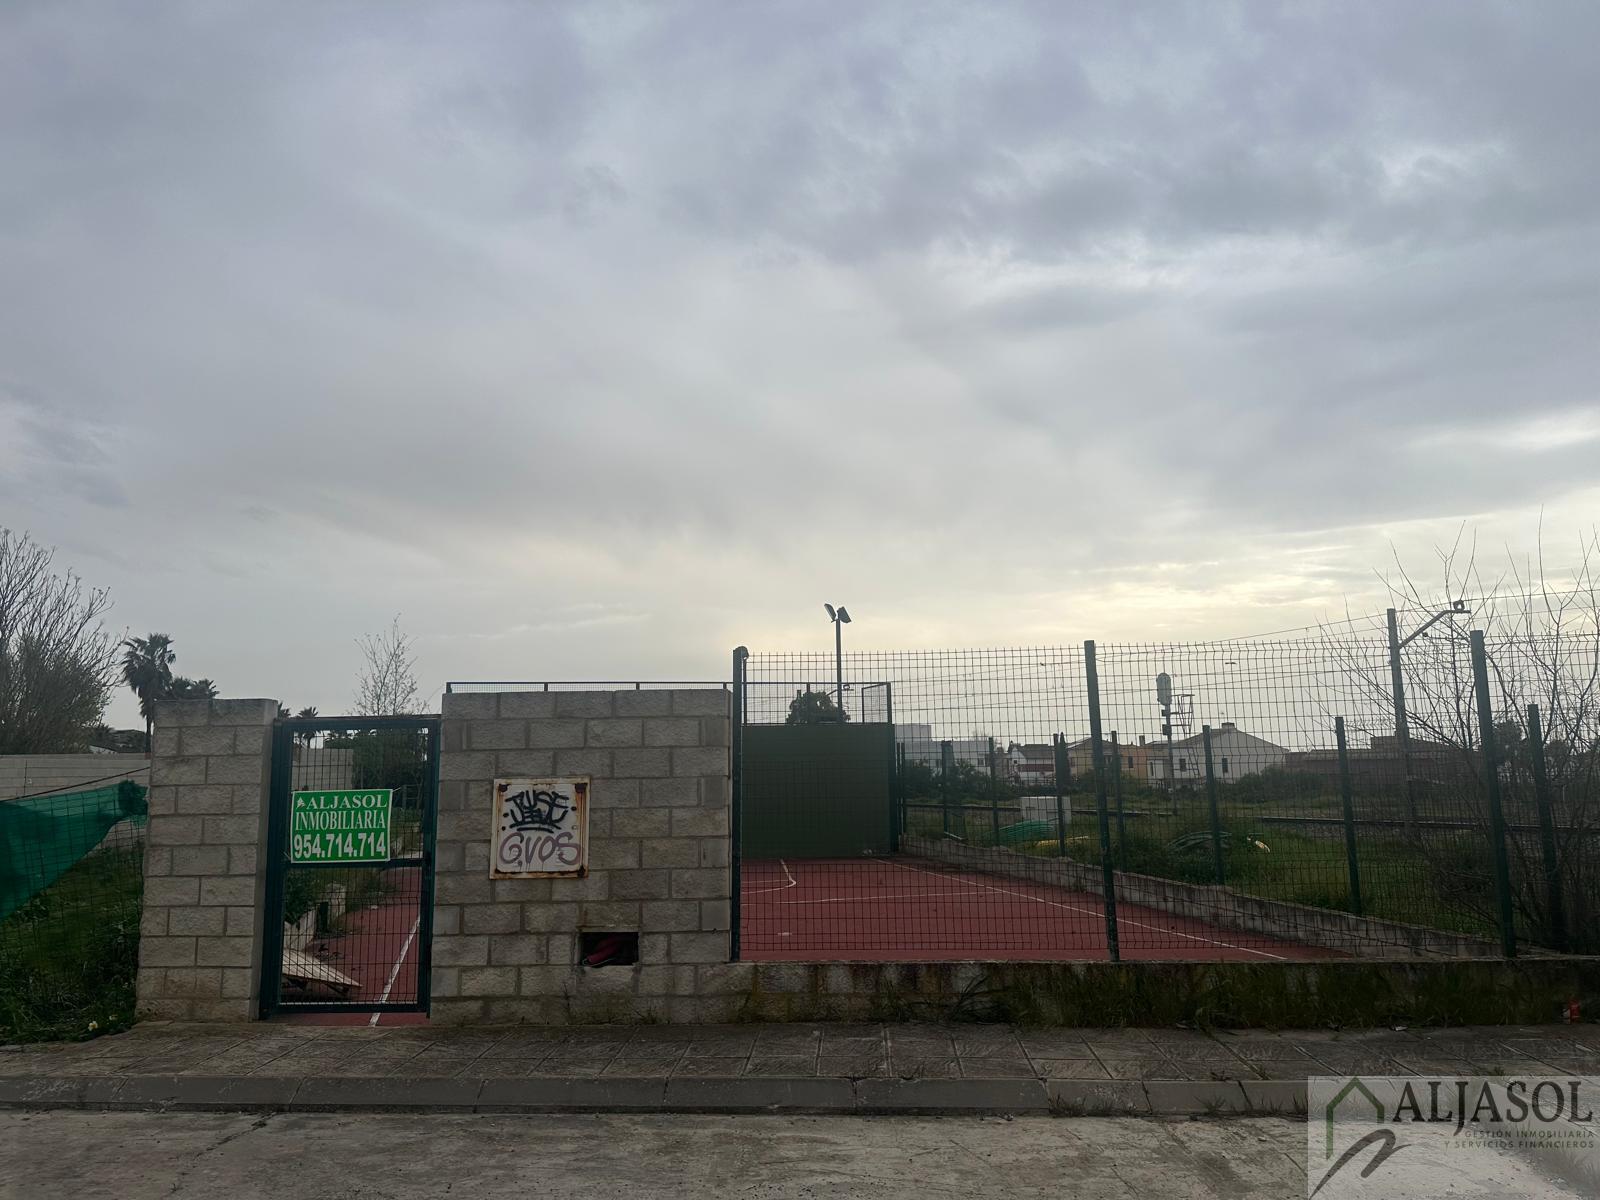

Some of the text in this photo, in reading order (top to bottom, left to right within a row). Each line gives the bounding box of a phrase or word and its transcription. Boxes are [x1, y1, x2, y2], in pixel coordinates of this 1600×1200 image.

[306, 795, 387, 810] ALJASOL
[295, 810, 386, 831] INMOBILIARIA
[294, 832, 386, 858] 954.714.714
